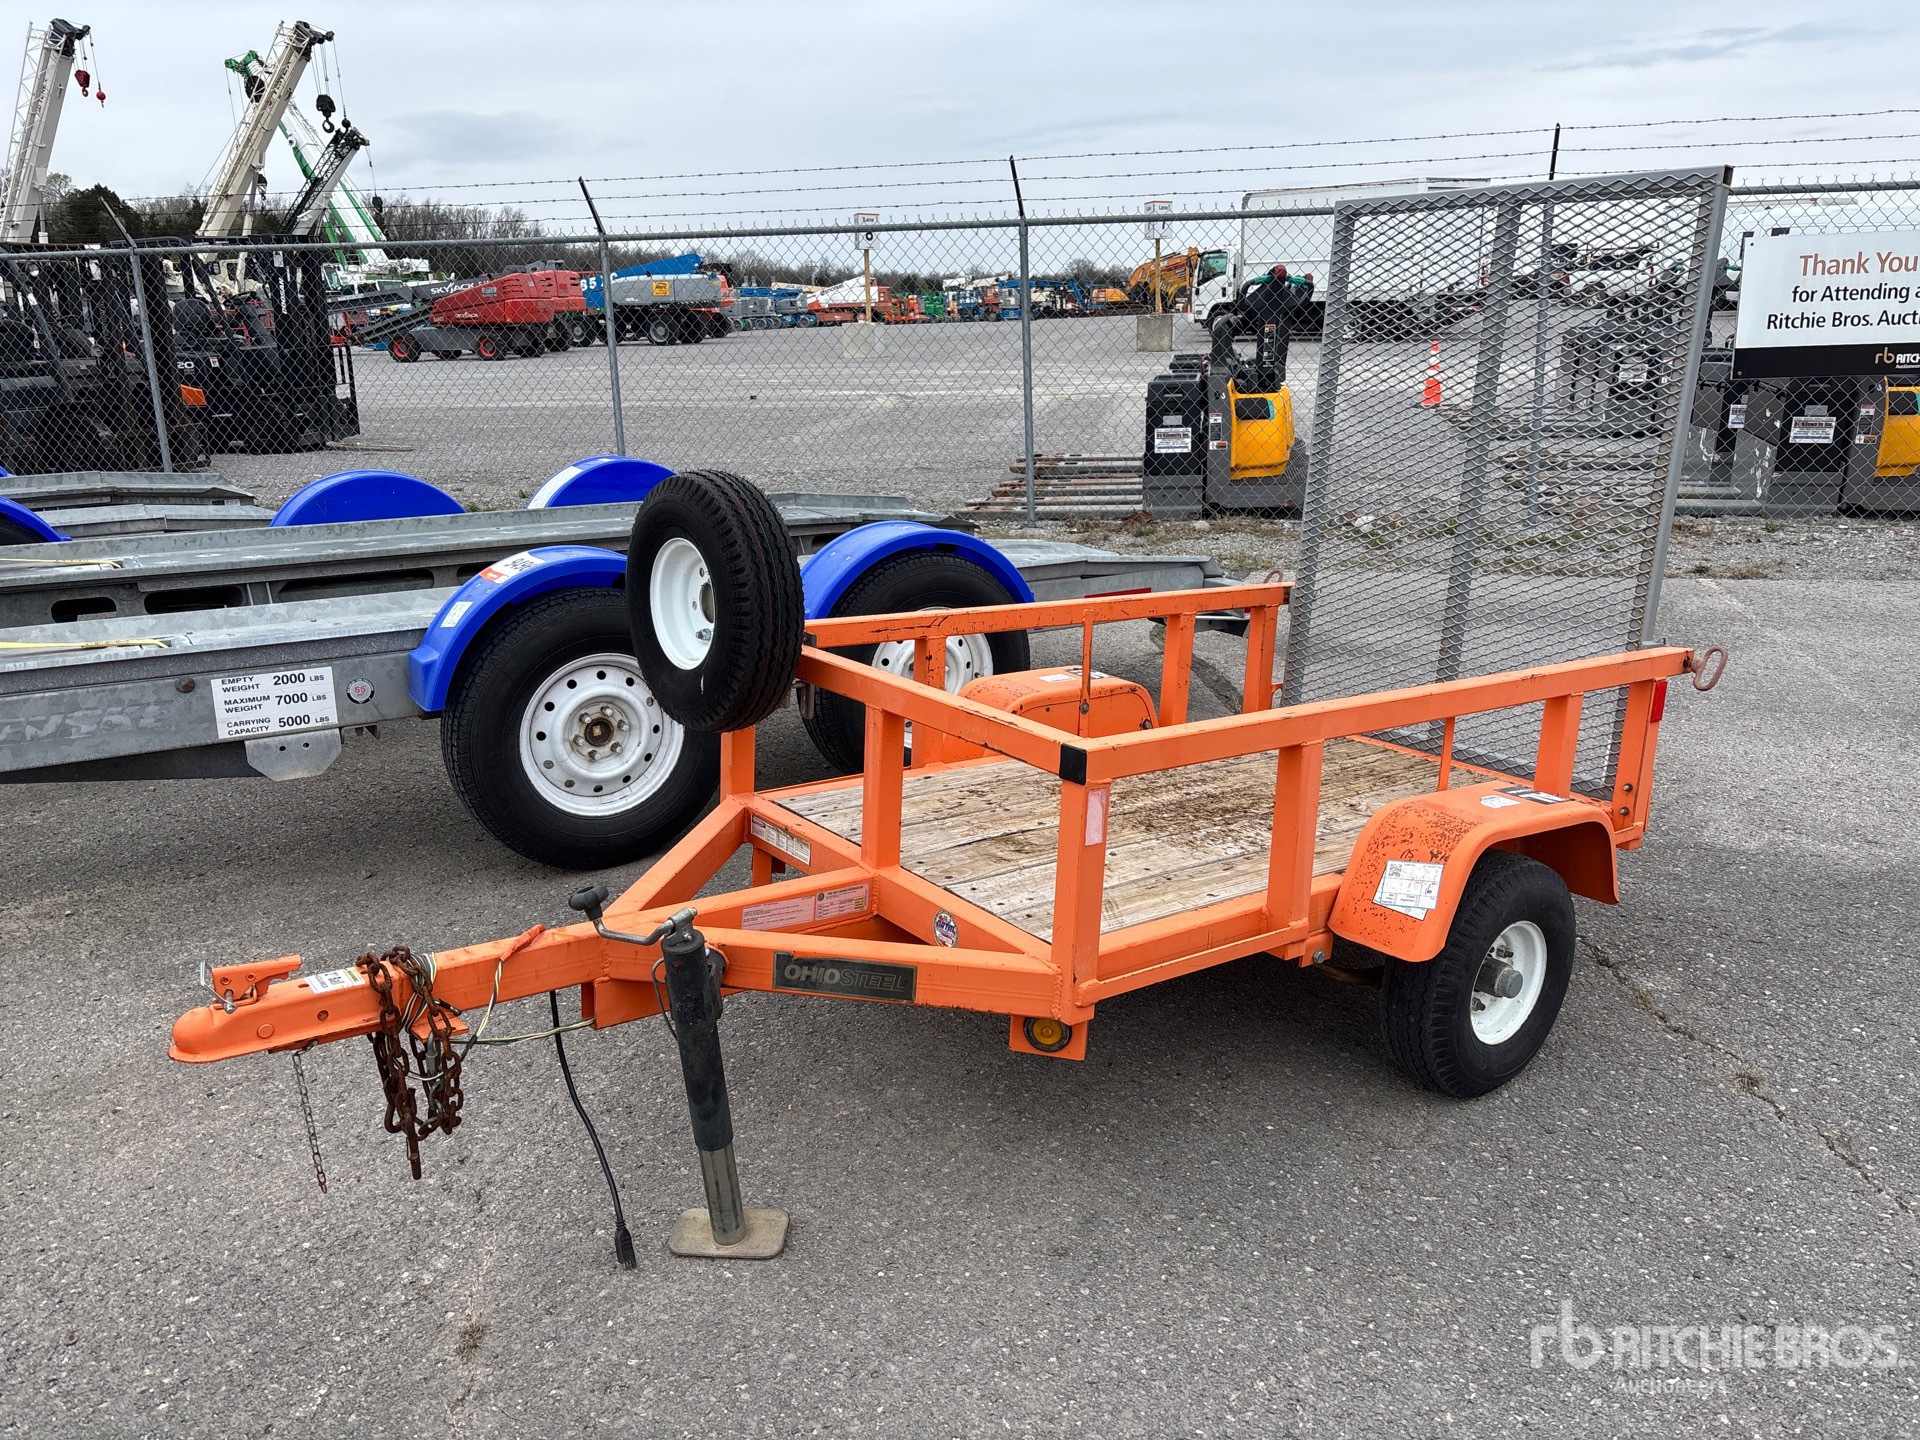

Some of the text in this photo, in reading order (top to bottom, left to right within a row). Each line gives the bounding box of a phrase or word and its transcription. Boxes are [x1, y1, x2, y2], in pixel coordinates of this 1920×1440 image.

[1800, 251, 1919, 276] Thank You
[430, 281, 475, 294] SKYJACK
[1792, 286, 1817, 303] for
[1820, 283, 1910, 303] Attending
[279, 277, 288, 315] DOOSAN
[1766, 312, 1826, 330] Ritchie
[1831, 311, 1873, 328] Bros.
[221, 676, 254, 685] EMPTY
[272, 672, 325, 686] 2000 LBS
[222, 683, 260, 693] WEIGHT
[354, 686, 366, 694] 65
[224, 694, 271, 706] MAXIMUM
[274, 692, 308, 706] 7000
[225, 703, 263, 714] WEIGHT
[226, 717, 271, 728] CARRYING
[278, 714, 311, 728] 5000
[227, 725, 270, 736] CAPACITY
